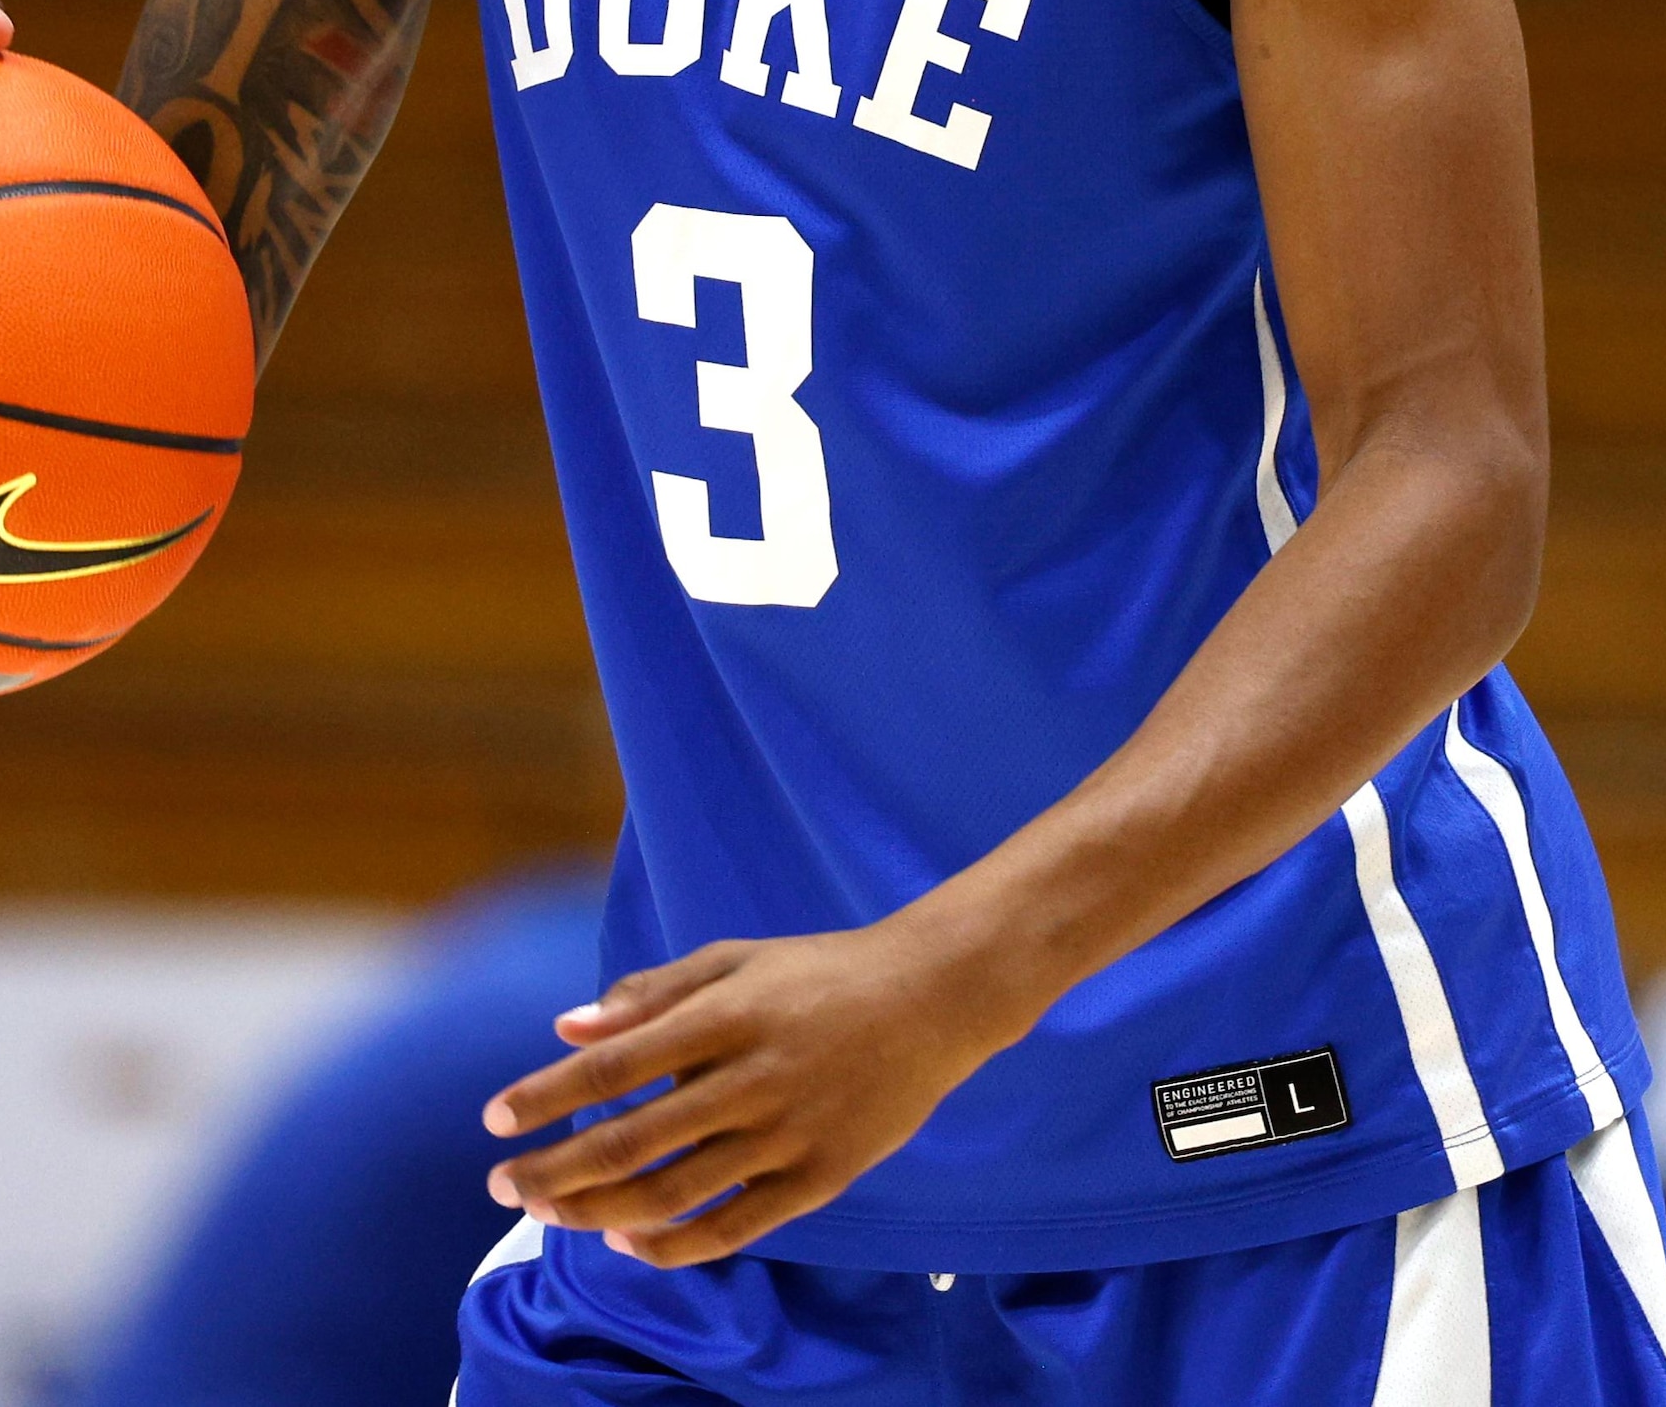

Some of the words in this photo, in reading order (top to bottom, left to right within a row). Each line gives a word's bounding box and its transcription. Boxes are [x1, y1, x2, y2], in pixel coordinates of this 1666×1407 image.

[630, 201, 840, 608] 3
[1162, 1075, 1256, 1103] ENGINEERED
[1288, 1082, 1315, 1114] L
[1165, 1103, 1174, 1111] TO
[1174, 1100, 1187, 1109] THE
[1165, 1110, 1176, 1118] OF
[1176, 1101, 1224, 1116] CHAMPIONSHIP
[1226, 1094, 1259, 1107] ATHLETES
